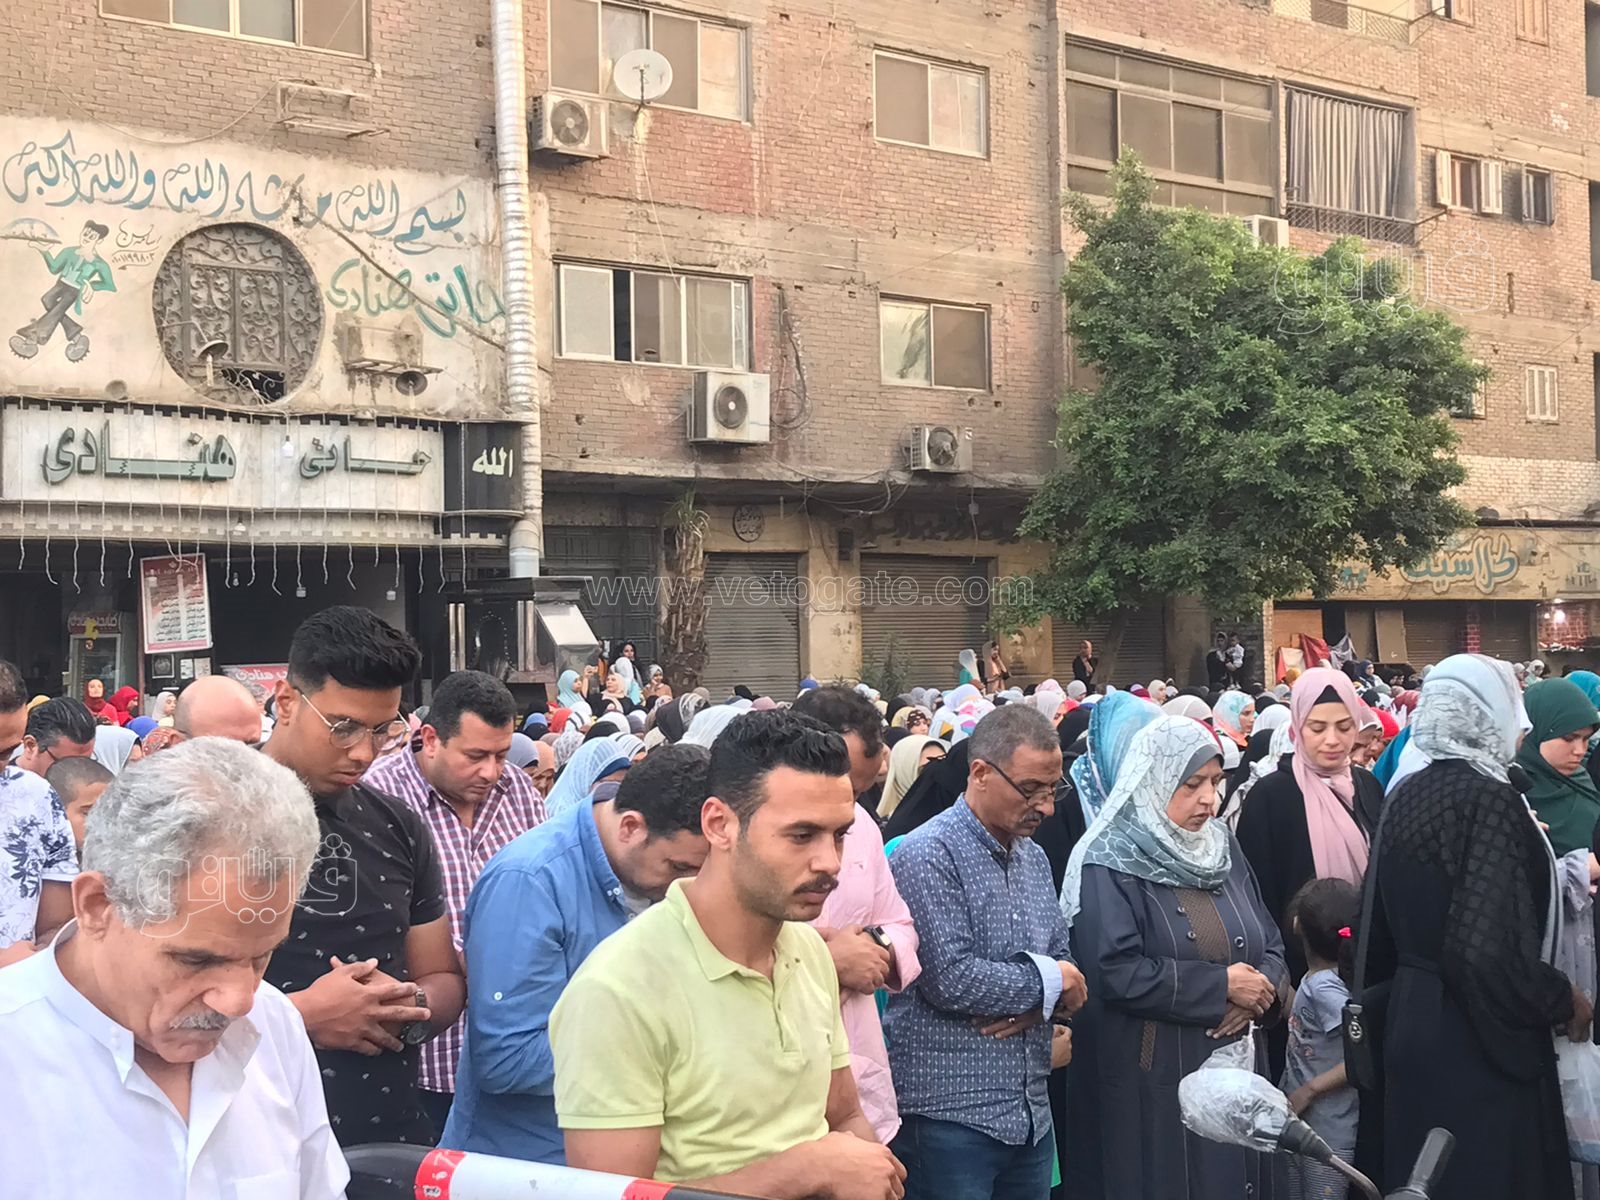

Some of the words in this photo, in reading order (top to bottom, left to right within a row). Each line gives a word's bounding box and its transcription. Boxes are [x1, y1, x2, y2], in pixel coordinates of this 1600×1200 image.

[163, 158, 229, 217] الله
[336, 178, 400, 236] الله
[394, 188, 466, 255] بسم
[472, 446, 513, 478] الله
